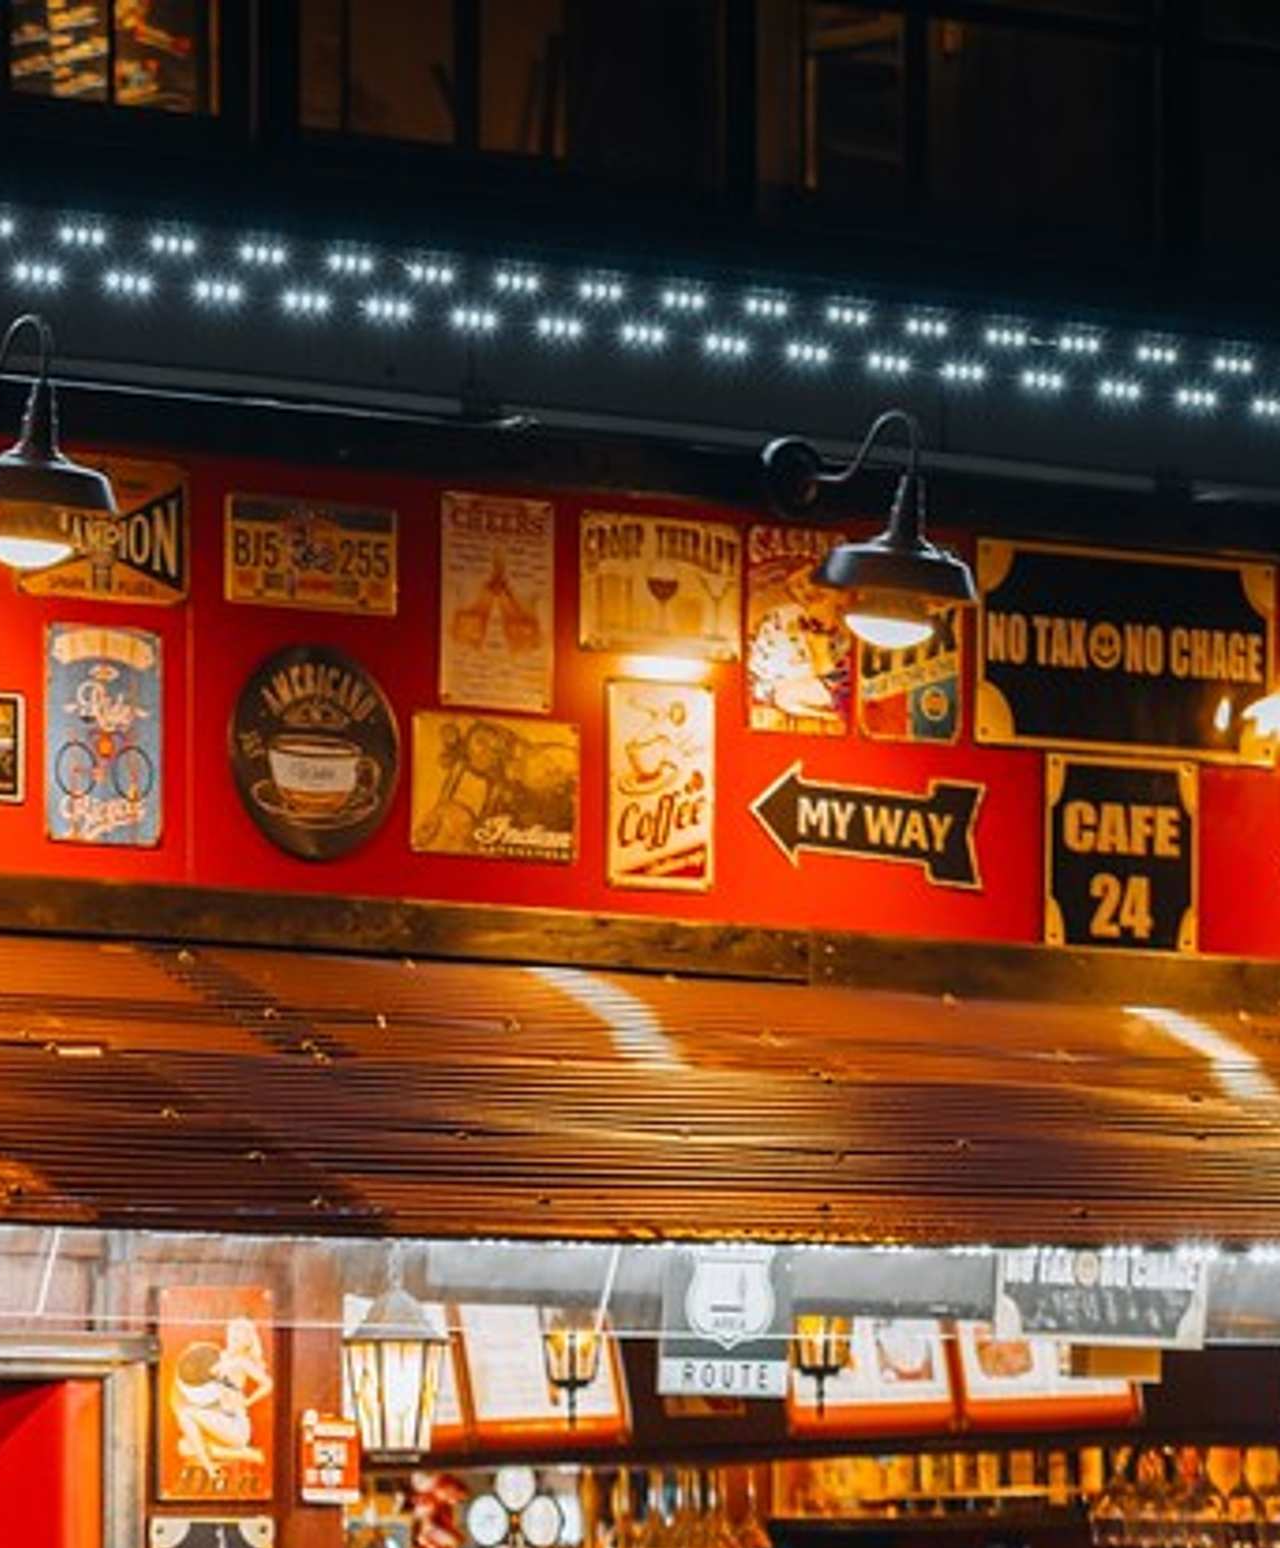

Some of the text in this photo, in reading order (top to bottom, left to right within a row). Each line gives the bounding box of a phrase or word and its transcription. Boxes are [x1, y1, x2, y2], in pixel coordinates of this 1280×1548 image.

[339, 540, 390, 578] 255
[988, 613, 1026, 664] NO
[1033, 617, 1089, 669] TAX
[1124, 623, 1163, 676] NO
[1169, 627, 1263, 684] CHAGE
[797, 797, 953, 853] MY WAY
[1063, 801, 1181, 858] CAFE
[1089, 873, 1153, 939] 24
[682, 1363, 769, 1389] ROUTE
